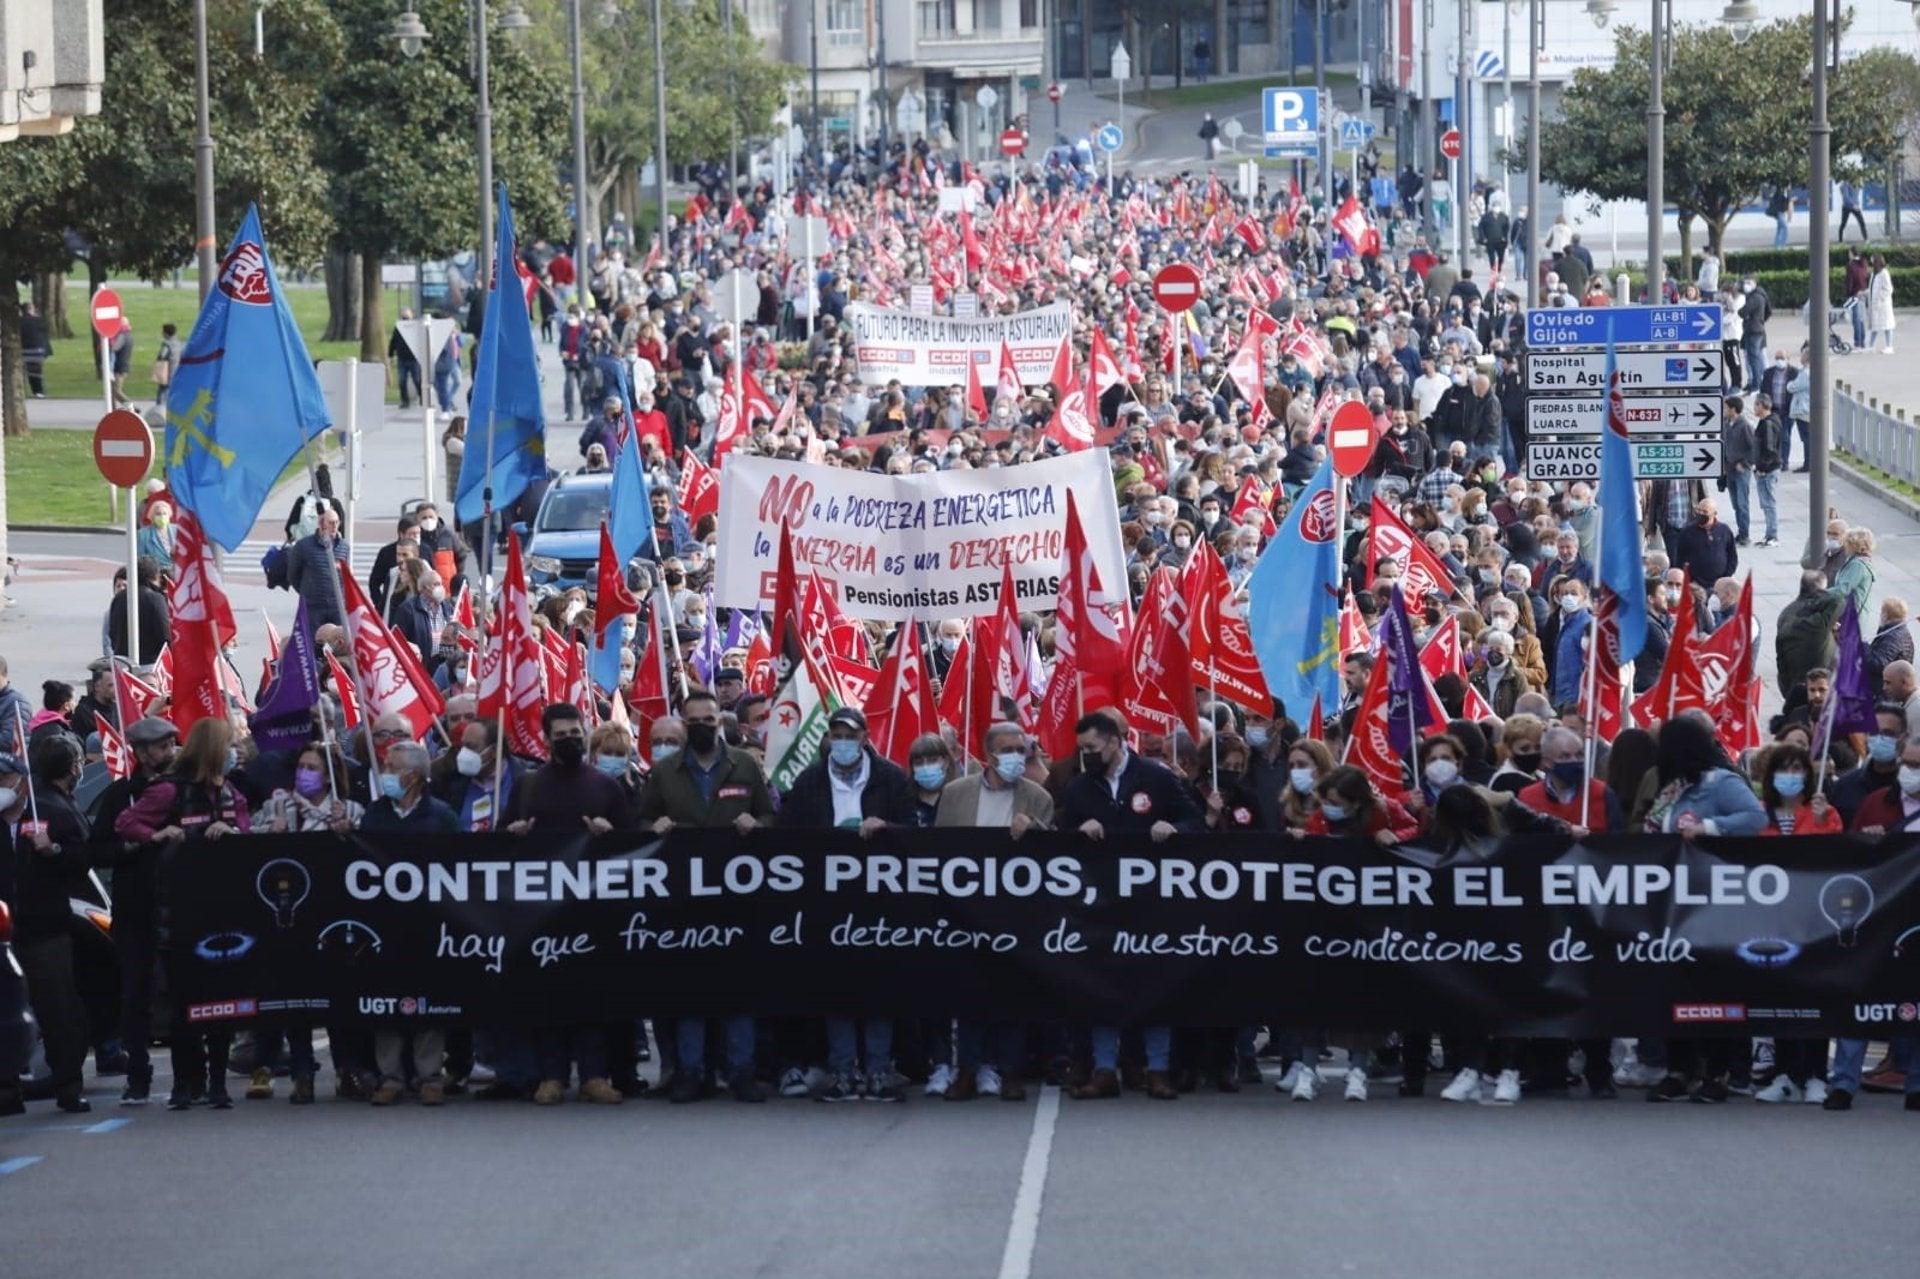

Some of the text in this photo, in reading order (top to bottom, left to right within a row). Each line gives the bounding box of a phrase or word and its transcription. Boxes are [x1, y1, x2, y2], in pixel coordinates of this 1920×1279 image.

[1274, 92, 1304, 131] P
[1533, 313, 1595, 326] Oviedo
[857, 313, 898, 341] FUTURO
[902, 315, 929, 342] PARA
[932, 319, 946, 343] LA
[948, 320, 1005, 344] INDUSTRIA
[1533, 327, 1578, 344] Gijón
[1654, 328, 1675, 338] A-8
[1533, 357, 1585, 370] hospital
[1534, 371, 1643, 388] San Agutín
[1533, 403, 1603, 414] PIEDRAS BLAN
[1627, 410, 1660, 420] N-632
[1533, 419, 1578, 429] LUARCA
[1639, 447, 1683, 457] AS-238
[1534, 463, 1597, 477] GRADO
[1640, 463, 1683, 474] AS-237
[758, 473, 814, 529] NO
[813, 503, 821, 519] a
[826, 497, 838, 523] la
[843, 494, 926, 535] POBREZA
[754, 531, 770, 557] la
[884, 553, 905, 575] es
[915, 553, 939, 570] un
[949, 529, 1061, 570] DERECHO
[845, 585, 959, 608] Pensionistas
[965, 576, 1060, 603] ASTRIAS
[345, 855, 1790, 906] CONTENER LOS PRECIOS, PROTEGER EL EMPLEO
[436, 911, 1698, 973] hay que frenar el deterioro de nuestras condiciones de vida
[190, 1002, 235, 1019] CCOO
[359, 996, 397, 1015] UGT
[1676, 1007, 1723, 1018] CCOO
[1855, 1004, 1896, 1021] UGT
